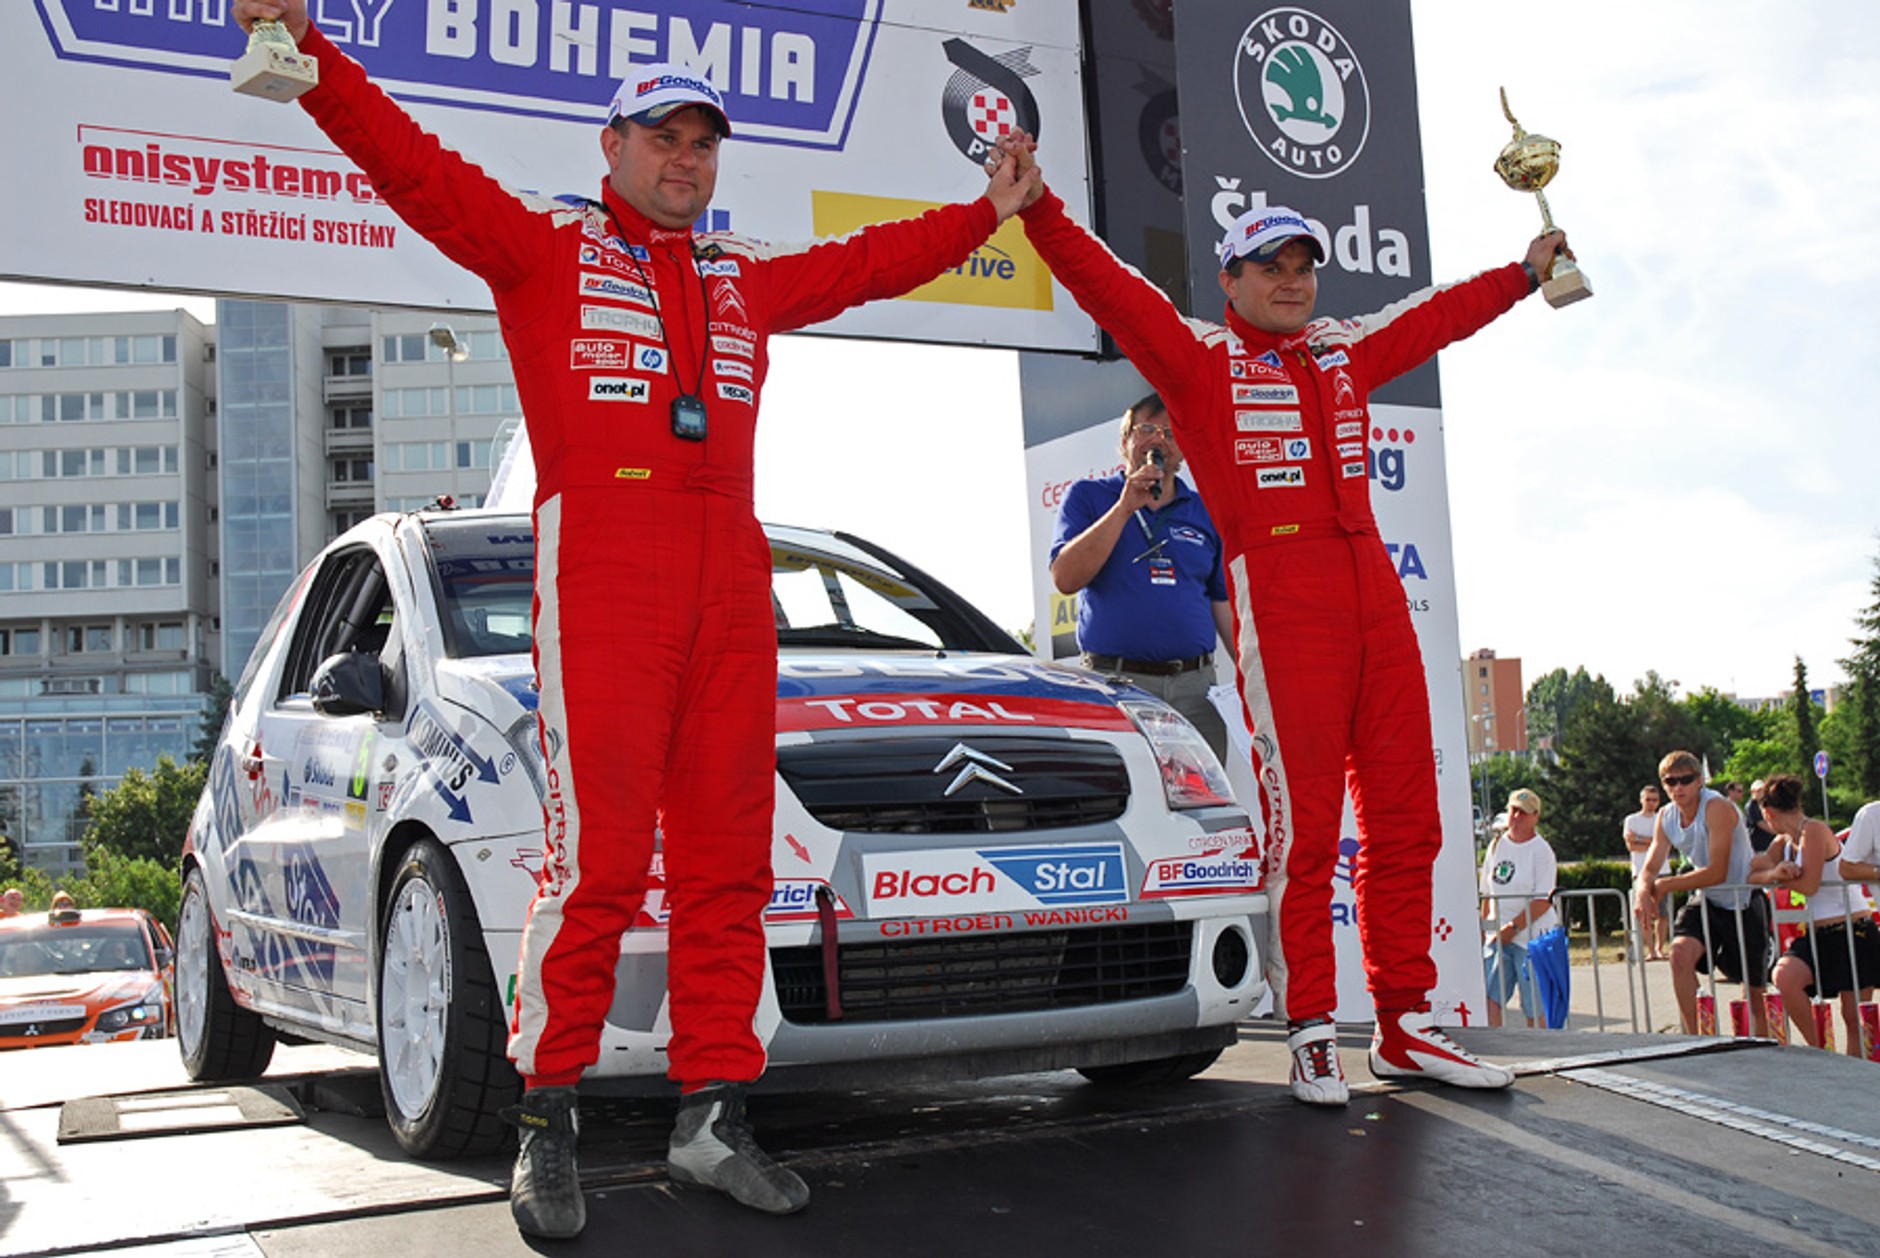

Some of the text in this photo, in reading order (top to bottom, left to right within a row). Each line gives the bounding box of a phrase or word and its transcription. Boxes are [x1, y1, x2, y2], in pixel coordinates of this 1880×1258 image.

[426, 0, 816, 103] BOHEMIA
[1243, 14, 1357, 82] ŠKODA
[1271, 137, 1343, 169] AUTO
[85, 198, 396, 249] SLEDOVACÍ A STŘEŽÍCÍ SYSTÉMY
[1210, 175, 1412, 278] Šoda
[594, 382, 645, 398] onet.pl
[805, 698, 1035, 723] TOTAL
[873, 861, 1106, 900] Blach Stal
[1158, 861, 1253, 880] BFGoodrich
[1023, 906, 1128, 928] WANICKI
